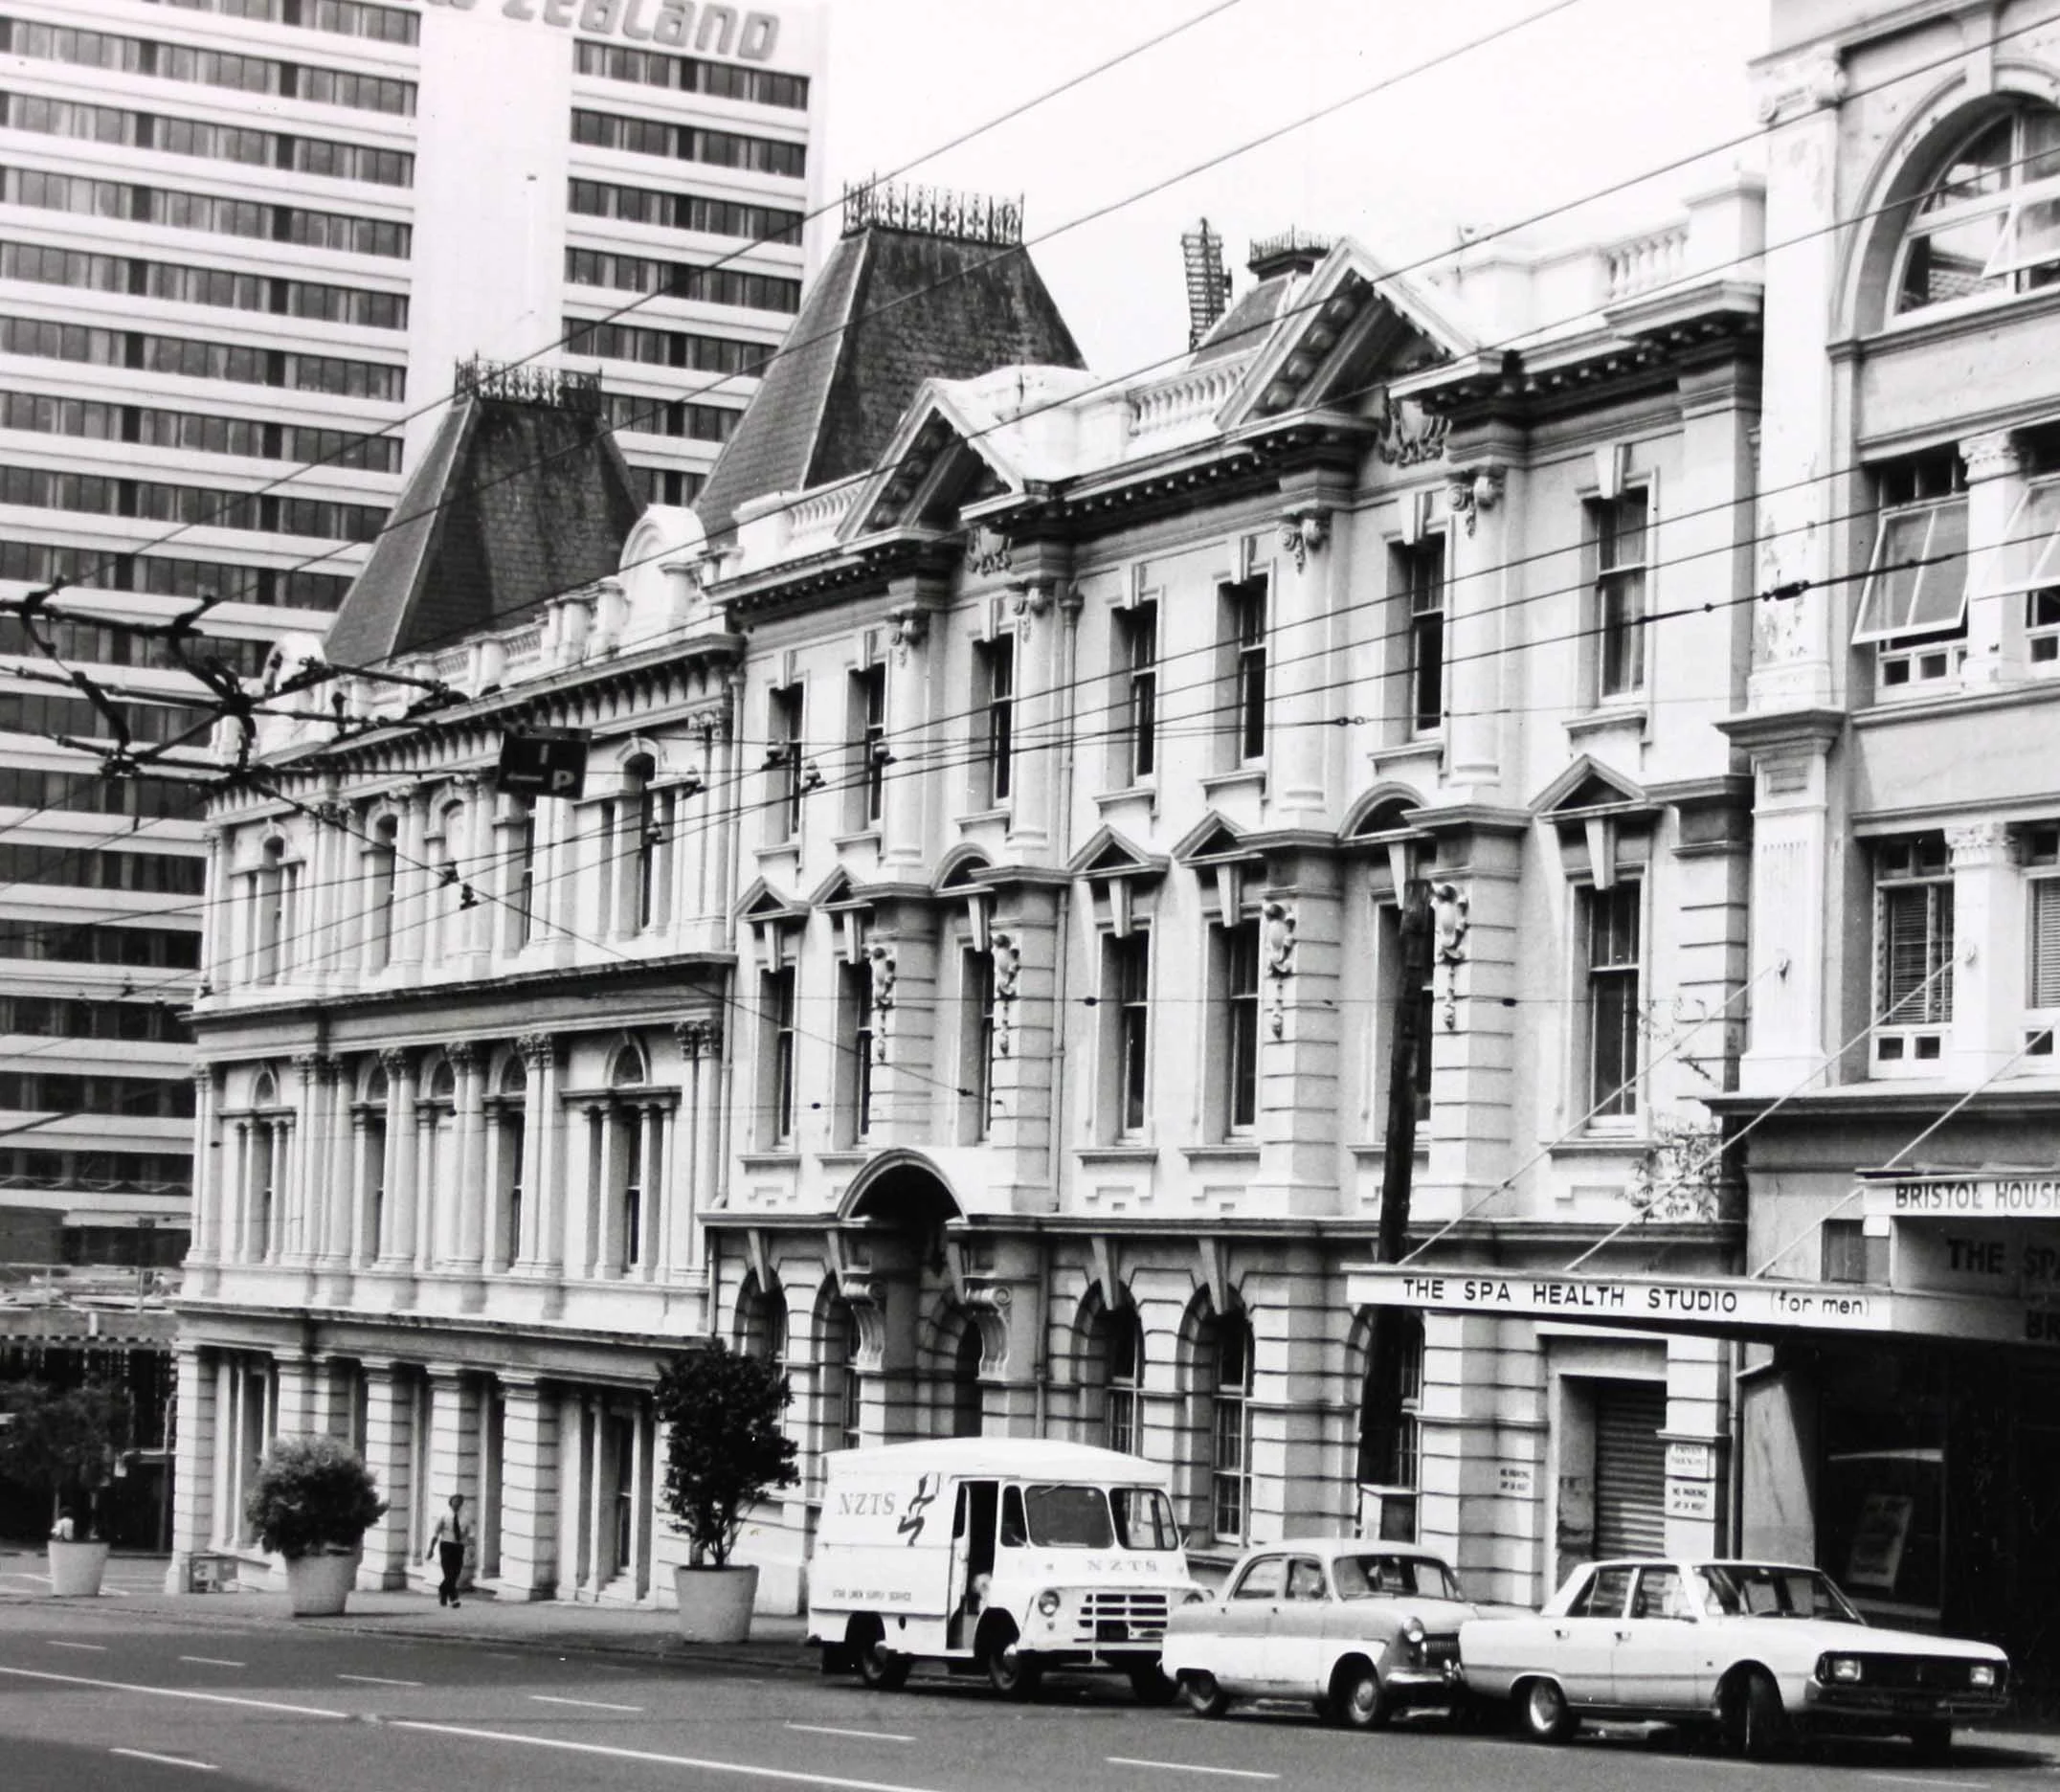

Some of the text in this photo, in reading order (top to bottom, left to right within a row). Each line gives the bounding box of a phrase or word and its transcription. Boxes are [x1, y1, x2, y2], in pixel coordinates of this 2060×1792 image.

[1895, 1181, 1983, 1209] BRISTOL
[1946, 1238, 2006, 1274] THE
[1403, 1278, 1444, 1300] THE
[1464, 1281, 1511, 1303] SPA
[1533, 1284, 1624, 1308] HEALTH
[1647, 1288, 1737, 1313] STUDIO
[836, 1491, 897, 1515] NZTS
[1086, 1558, 1157, 1572] NZTS
